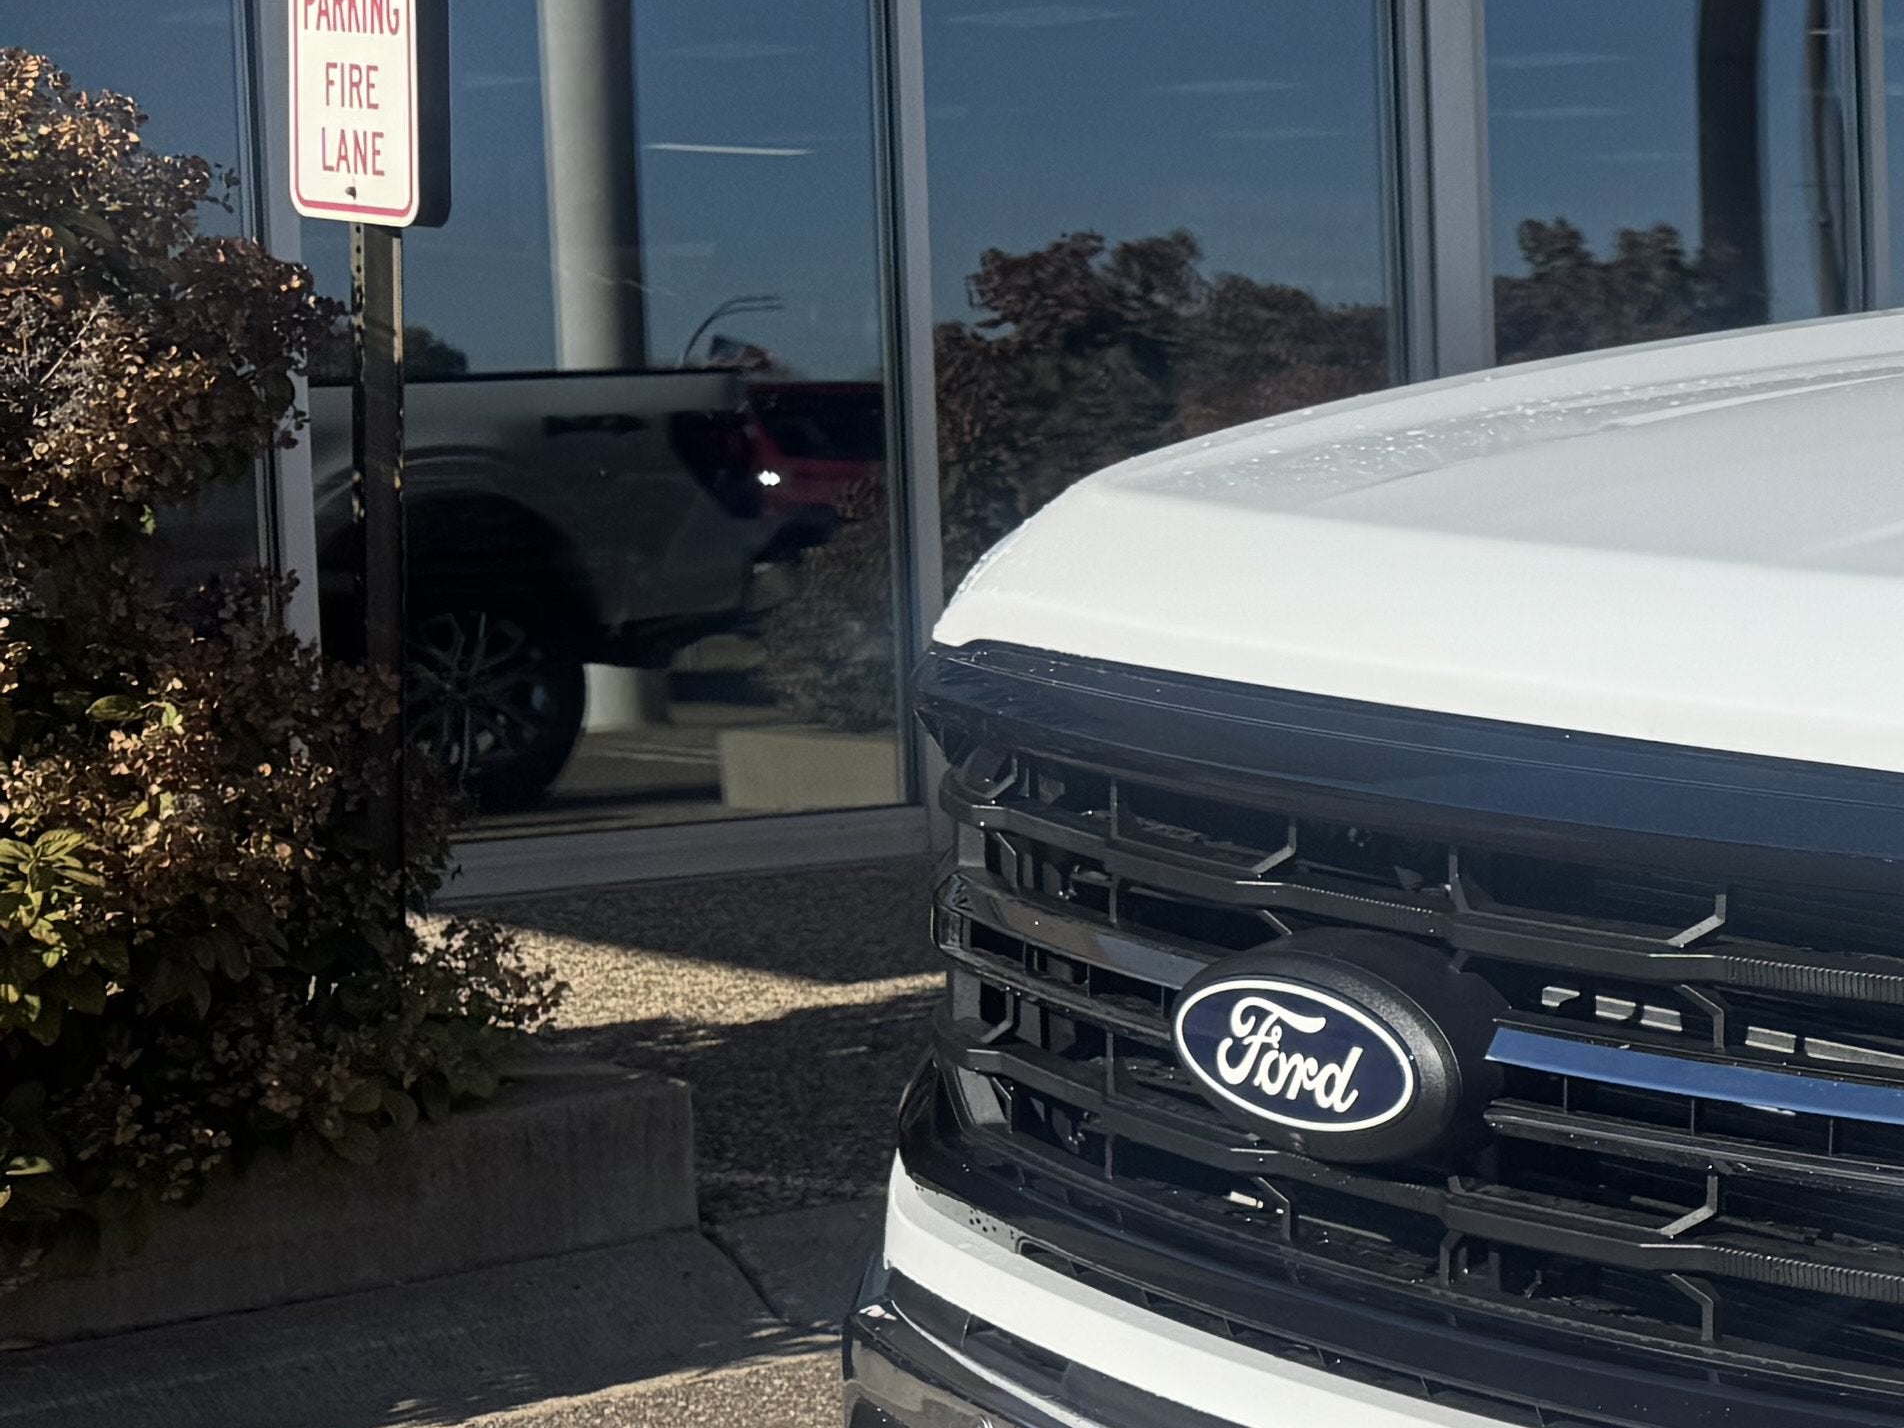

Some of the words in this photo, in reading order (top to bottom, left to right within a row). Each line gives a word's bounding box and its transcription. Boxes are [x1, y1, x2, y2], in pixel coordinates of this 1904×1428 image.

[324, 61, 380, 110] FIRE
[320, 126, 386, 177] LANE
[1216, 996, 1364, 1113] Ford
